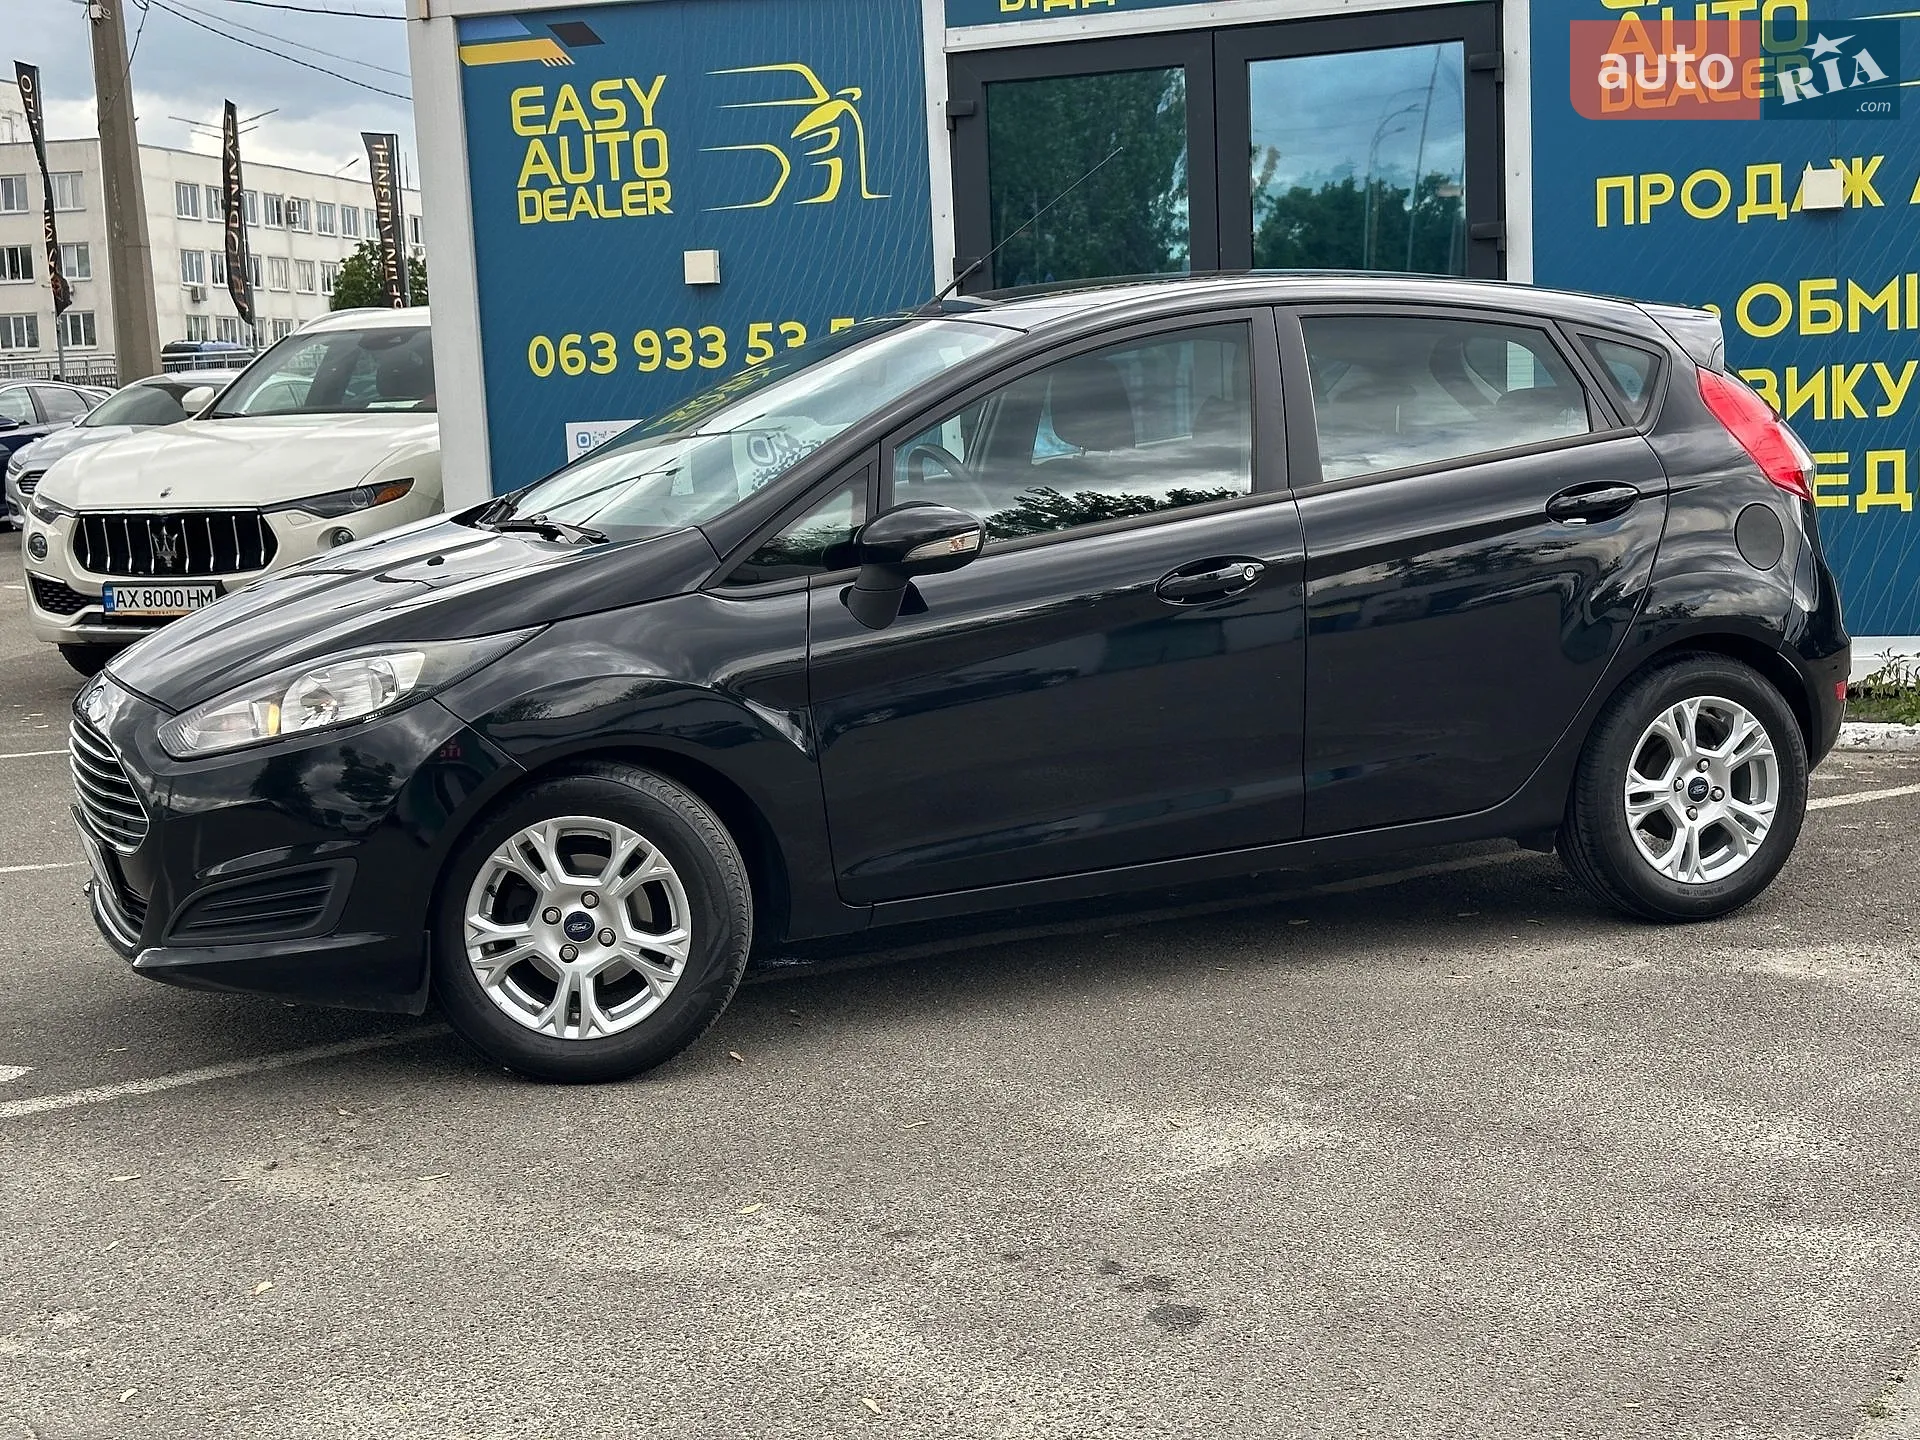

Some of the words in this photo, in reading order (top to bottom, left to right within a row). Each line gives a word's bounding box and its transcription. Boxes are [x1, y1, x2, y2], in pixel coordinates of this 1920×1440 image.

[510, 75, 667, 136] EASY
[517, 128, 669, 188] AUTO
[518, 179, 673, 224] DEALER
[528, 333, 617, 378] 063
[633, 325, 727, 372] 933
[116, 590, 140, 608] AX
[143, 590, 184, 608] 8000
[187, 589, 213, 608] HM
